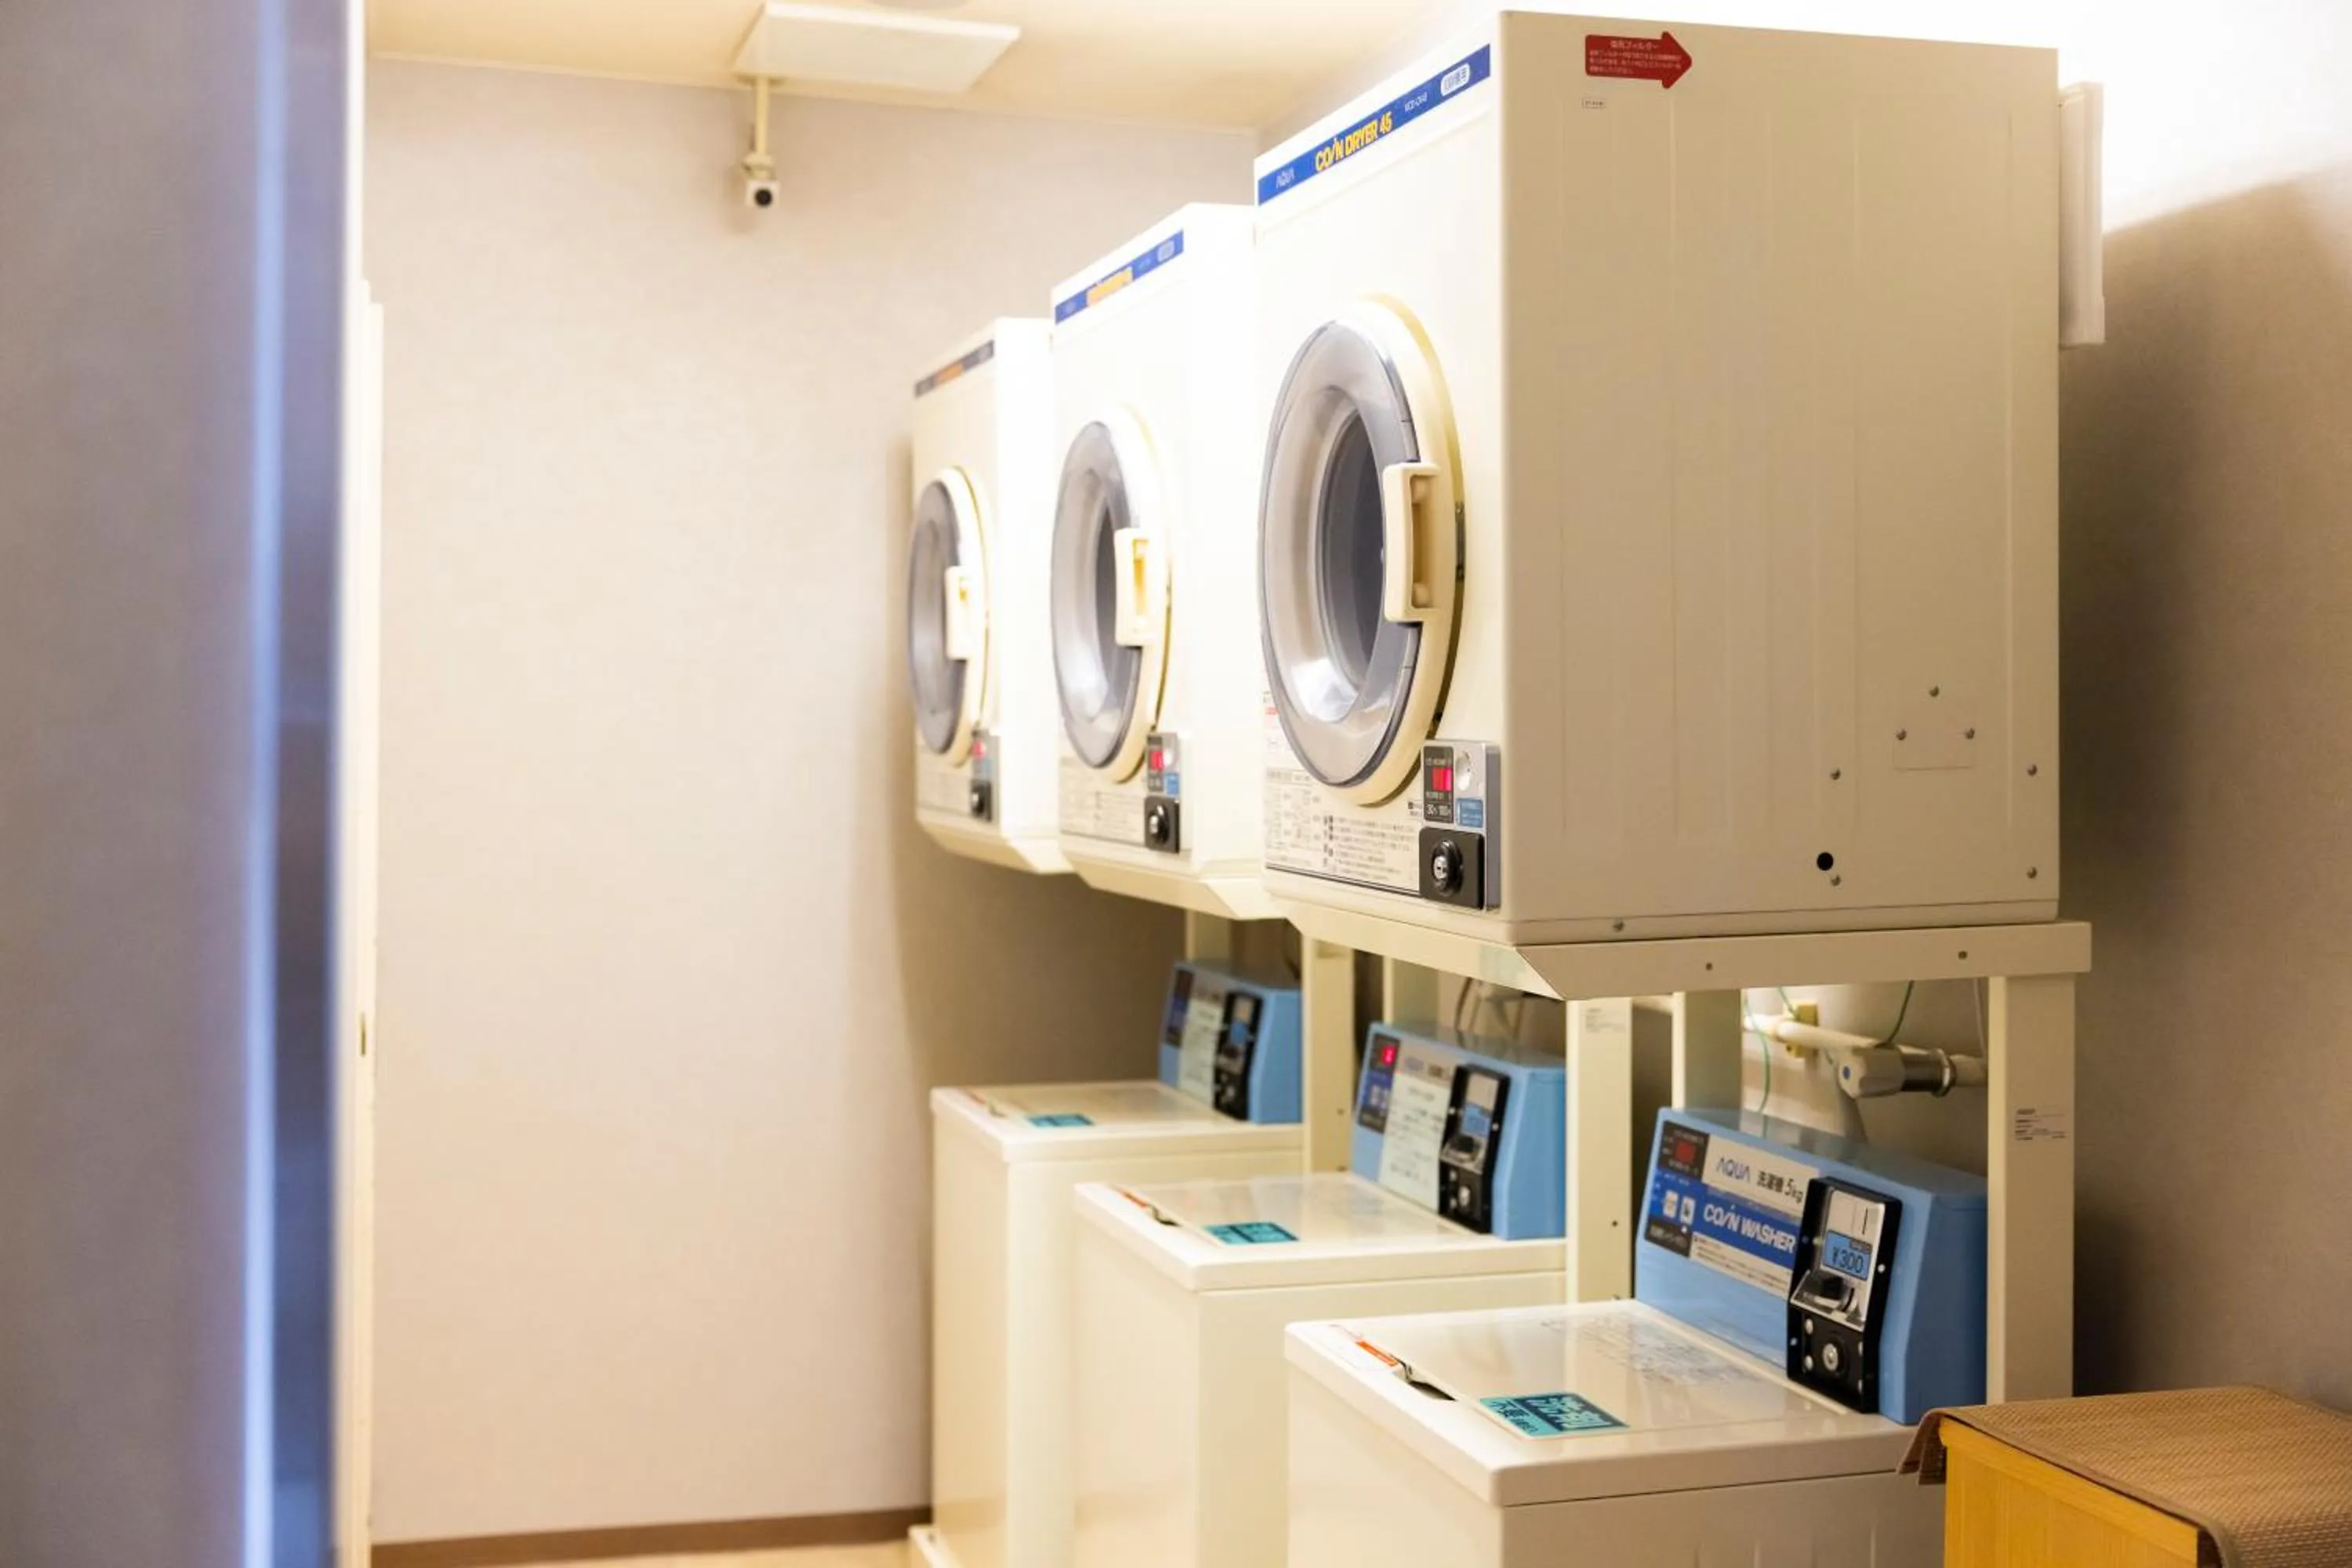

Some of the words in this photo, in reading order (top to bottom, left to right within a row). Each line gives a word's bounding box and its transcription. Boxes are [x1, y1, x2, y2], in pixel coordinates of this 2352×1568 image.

[1345, 120, 1377, 155] DRYER
[1716, 1155, 1751, 1183] AQUA
[1741, 1216, 1797, 1254] WASHER
